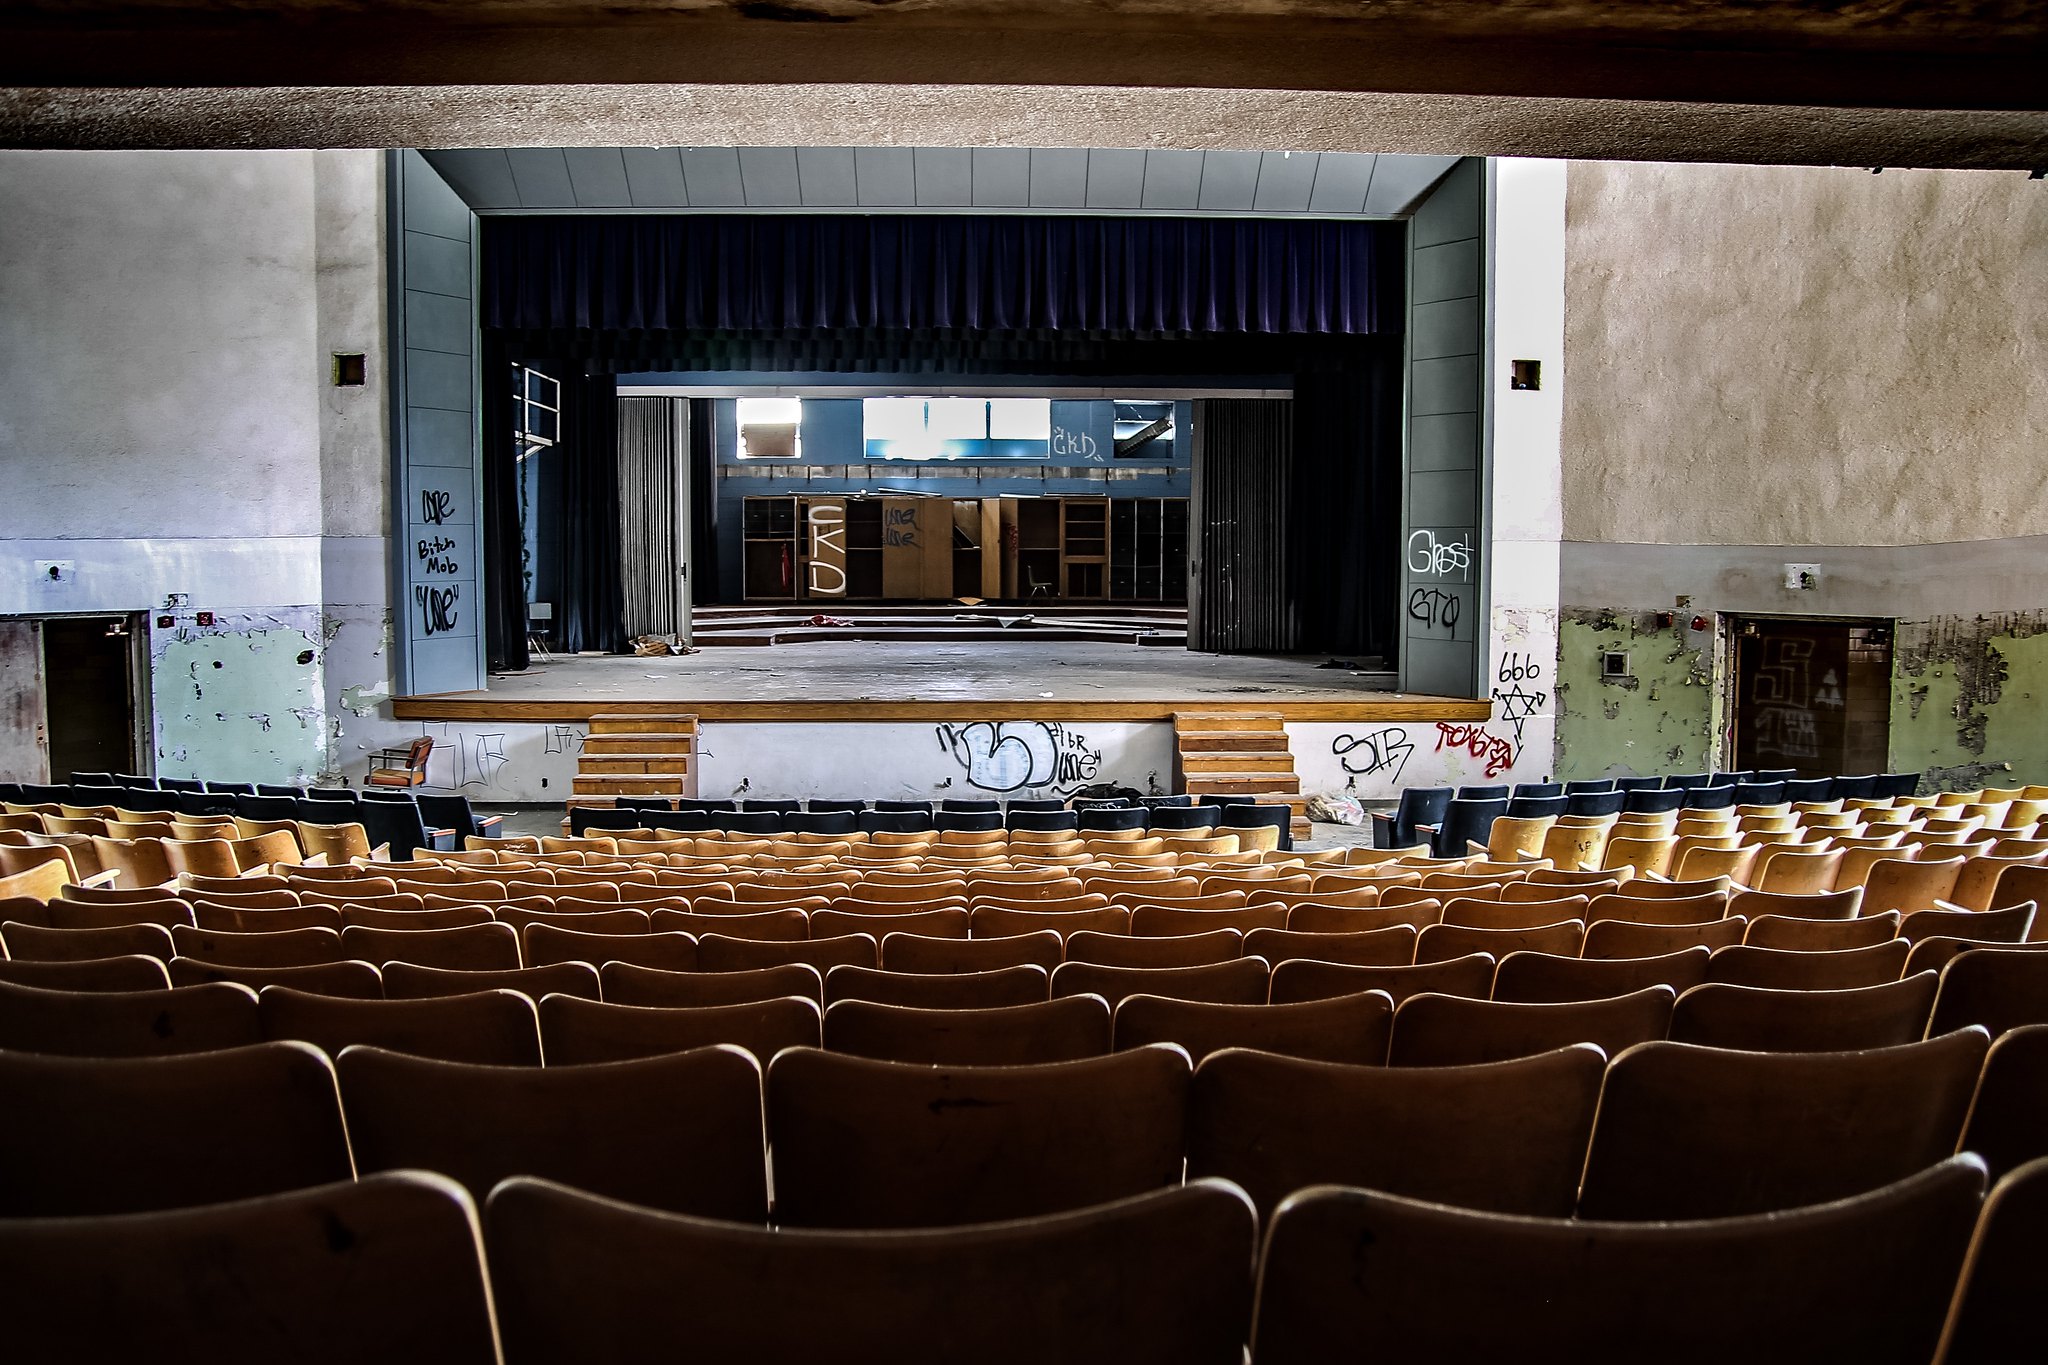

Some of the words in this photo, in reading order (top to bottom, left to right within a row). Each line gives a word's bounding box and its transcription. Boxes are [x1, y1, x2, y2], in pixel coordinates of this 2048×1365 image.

[418, 536, 456, 560] Bitch
[1407, 530, 1475, 582] Ghost
[426, 556, 458, 574] Mob
